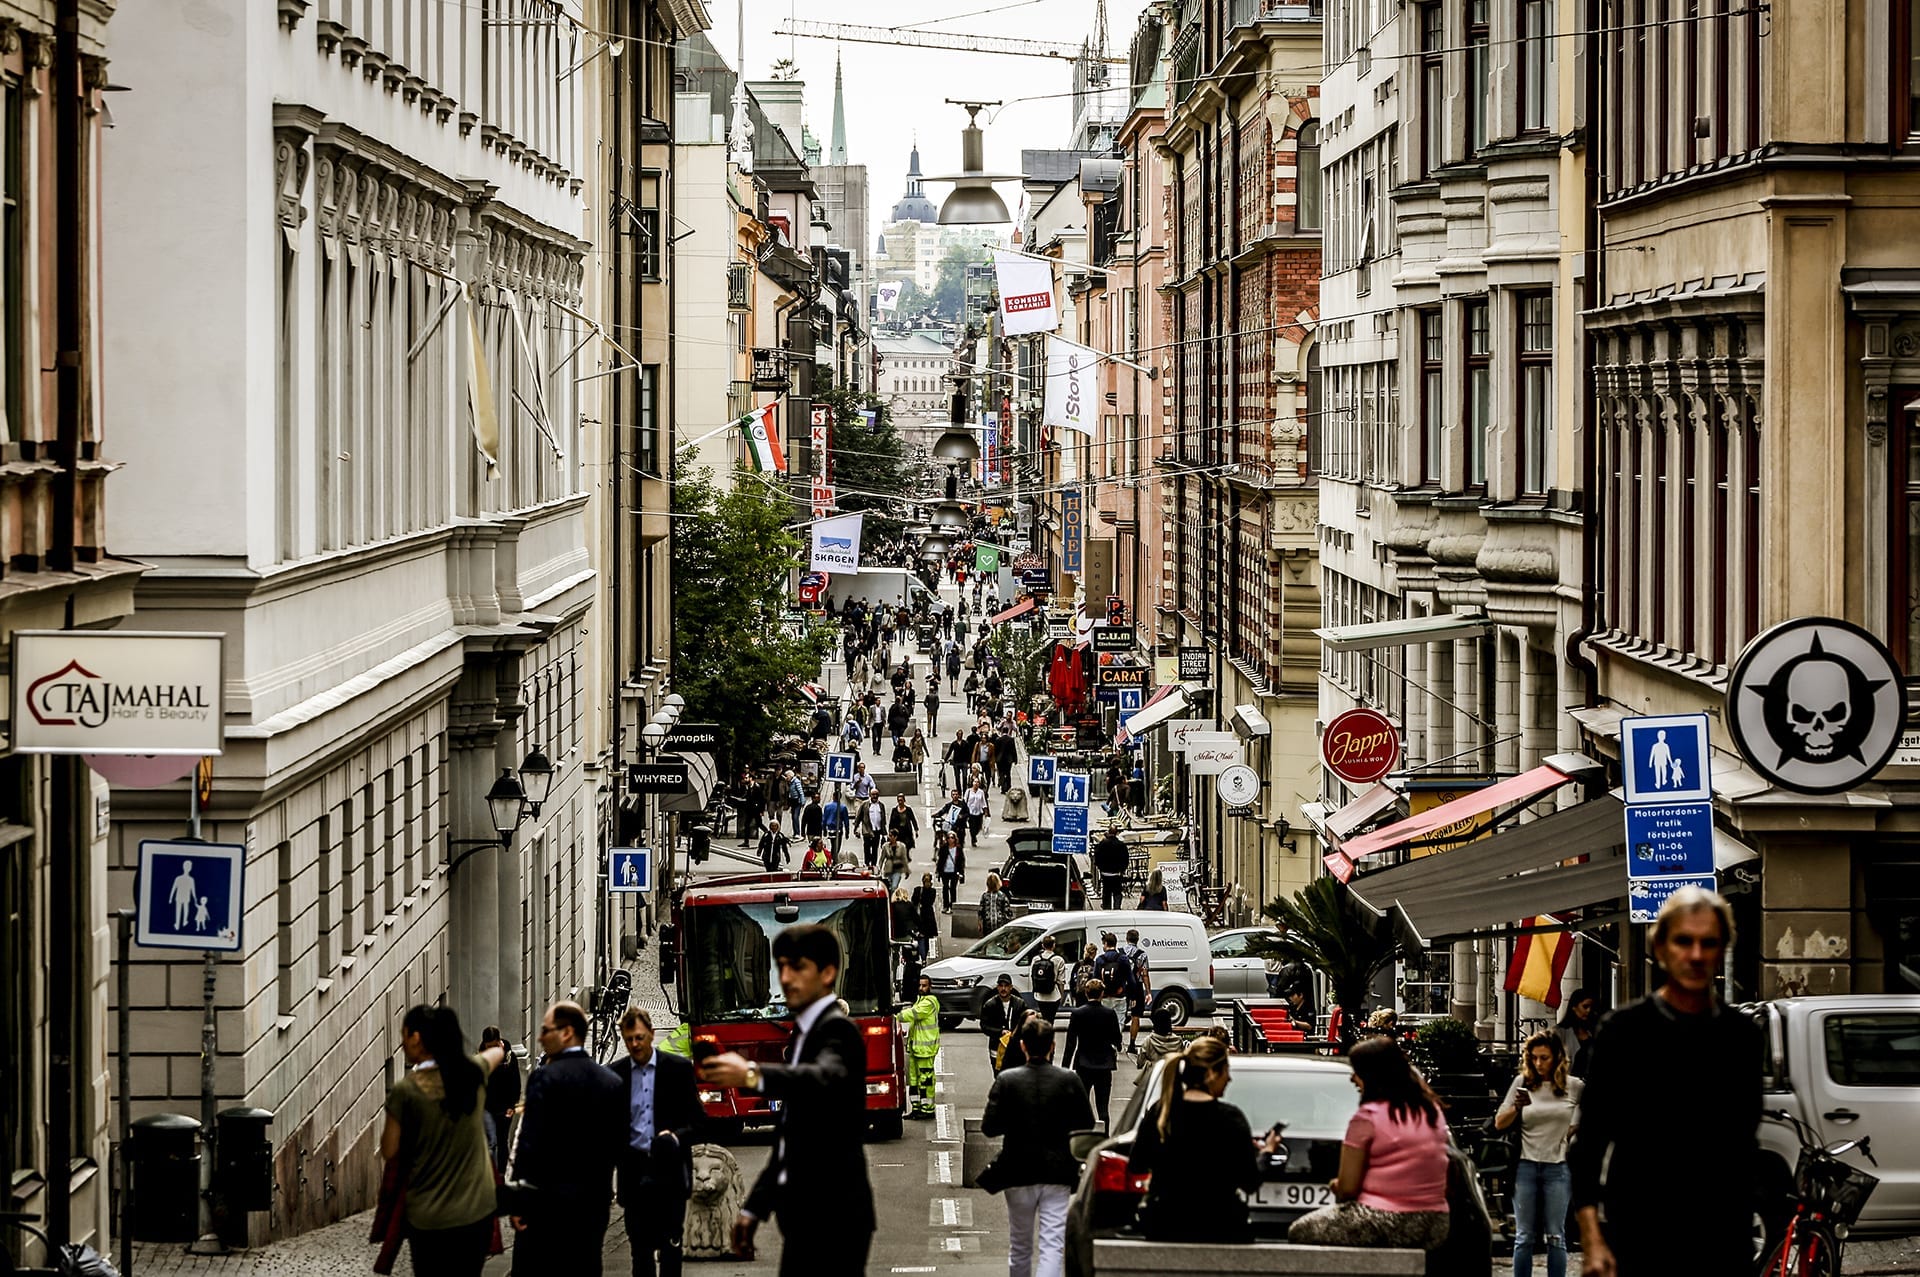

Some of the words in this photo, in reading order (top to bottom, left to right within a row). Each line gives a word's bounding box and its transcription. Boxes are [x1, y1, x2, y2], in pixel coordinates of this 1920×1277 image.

[1007, 294, 1047, 305] KONSULT
[1008, 301, 1047, 311] KOMPANIET
[1066, 498, 1079, 567] HOTEL
[815, 554, 855, 564] SKAGEN
[1102, 670, 1145, 682] CARAT
[1182, 667, 1198, 675] FOOD
[43, 683, 111, 728] TAJ
[112, 685, 209, 707] MAHAL
[112, 708, 138, 719] Hair
[159, 708, 208, 722] Beauty
[667, 734, 715, 744] synoptik
[1331, 725, 1390, 765] Jappi
[634, 774, 683, 784] WHYRED
[1634, 808, 1703, 818] Motorfordons-
[1656, 819, 1682, 828] trafik
[1647, 830, 1693, 840] förbjuden
[1658, 842, 1683, 851] 11-06
[1655, 852, 1687, 863] (11-06)
[1152, 938, 1188, 947] Anticimex
[1287, 1185, 1331, 1206] 902
